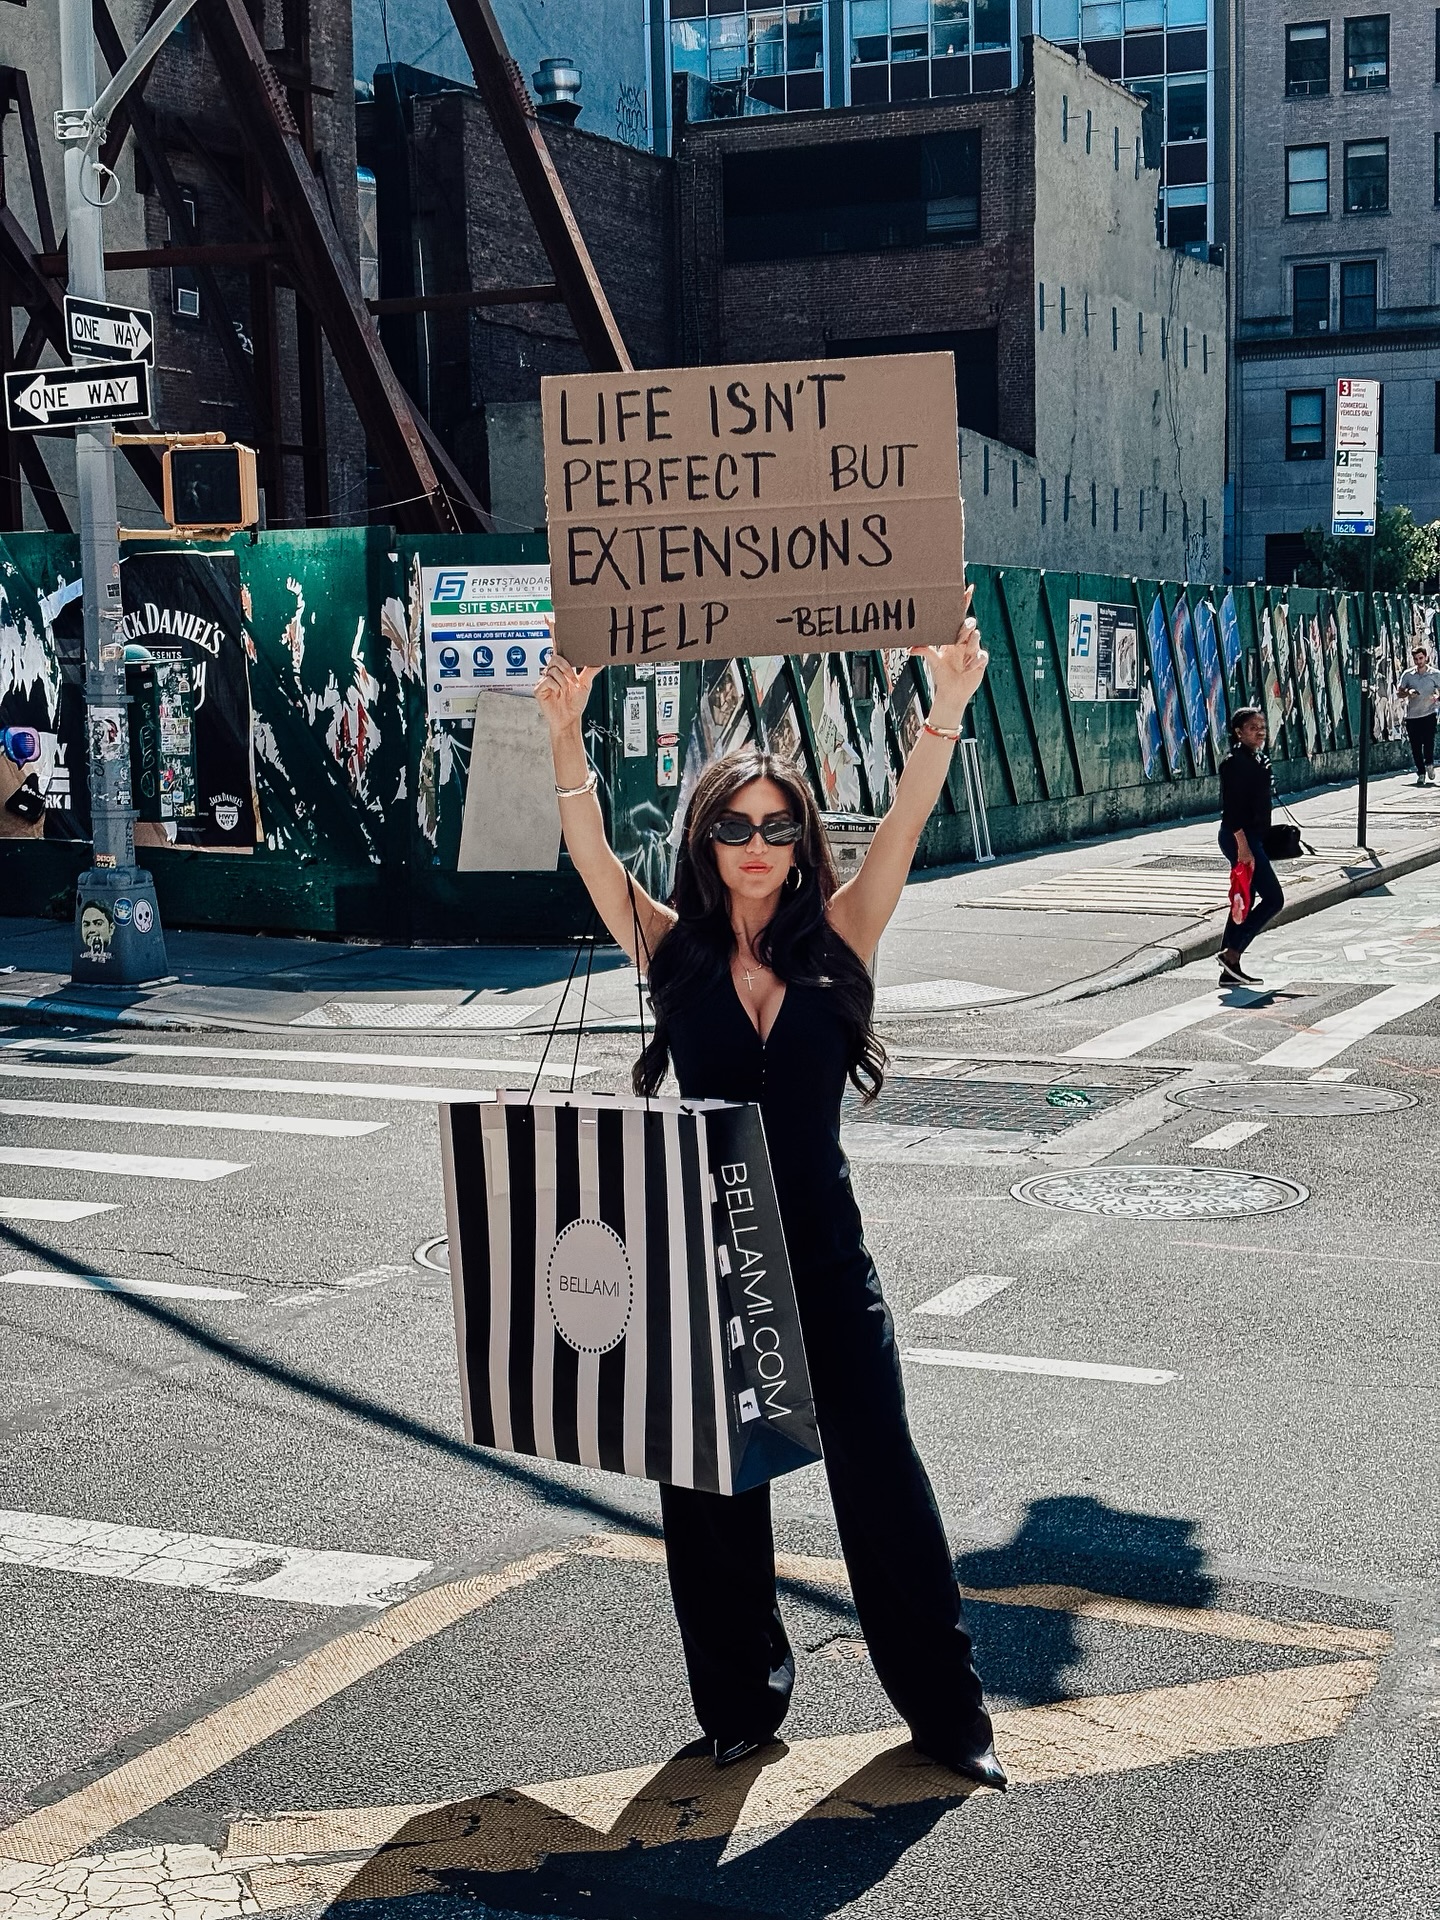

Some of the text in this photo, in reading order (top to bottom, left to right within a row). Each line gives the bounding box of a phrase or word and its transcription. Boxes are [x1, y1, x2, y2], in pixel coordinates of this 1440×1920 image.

[75, 316, 141, 347] ONE WAY
[30, 381, 128, 410] ONE WAY
[1342, 382, 1349, 396] 3
[560, 374, 846, 446] LIFE ISN'T
[1339, 452, 1346, 465] 2
[563, 444, 918, 512] PERFECT BUT
[567, 514, 892, 590] EXTENSIONS
[472, 577, 550, 586] FIRSTSTANDAR
[459, 602, 539, 614] SITE SAFETY
[122, 603, 226, 654] CK DANIEL'S
[608, 601, 729, 657] HELP
[152, 651, 182, 659] ESENTS
[560, 1275, 619, 1297] BELLAMI
[722, 1162, 792, 1420] BELLAMI.COM
